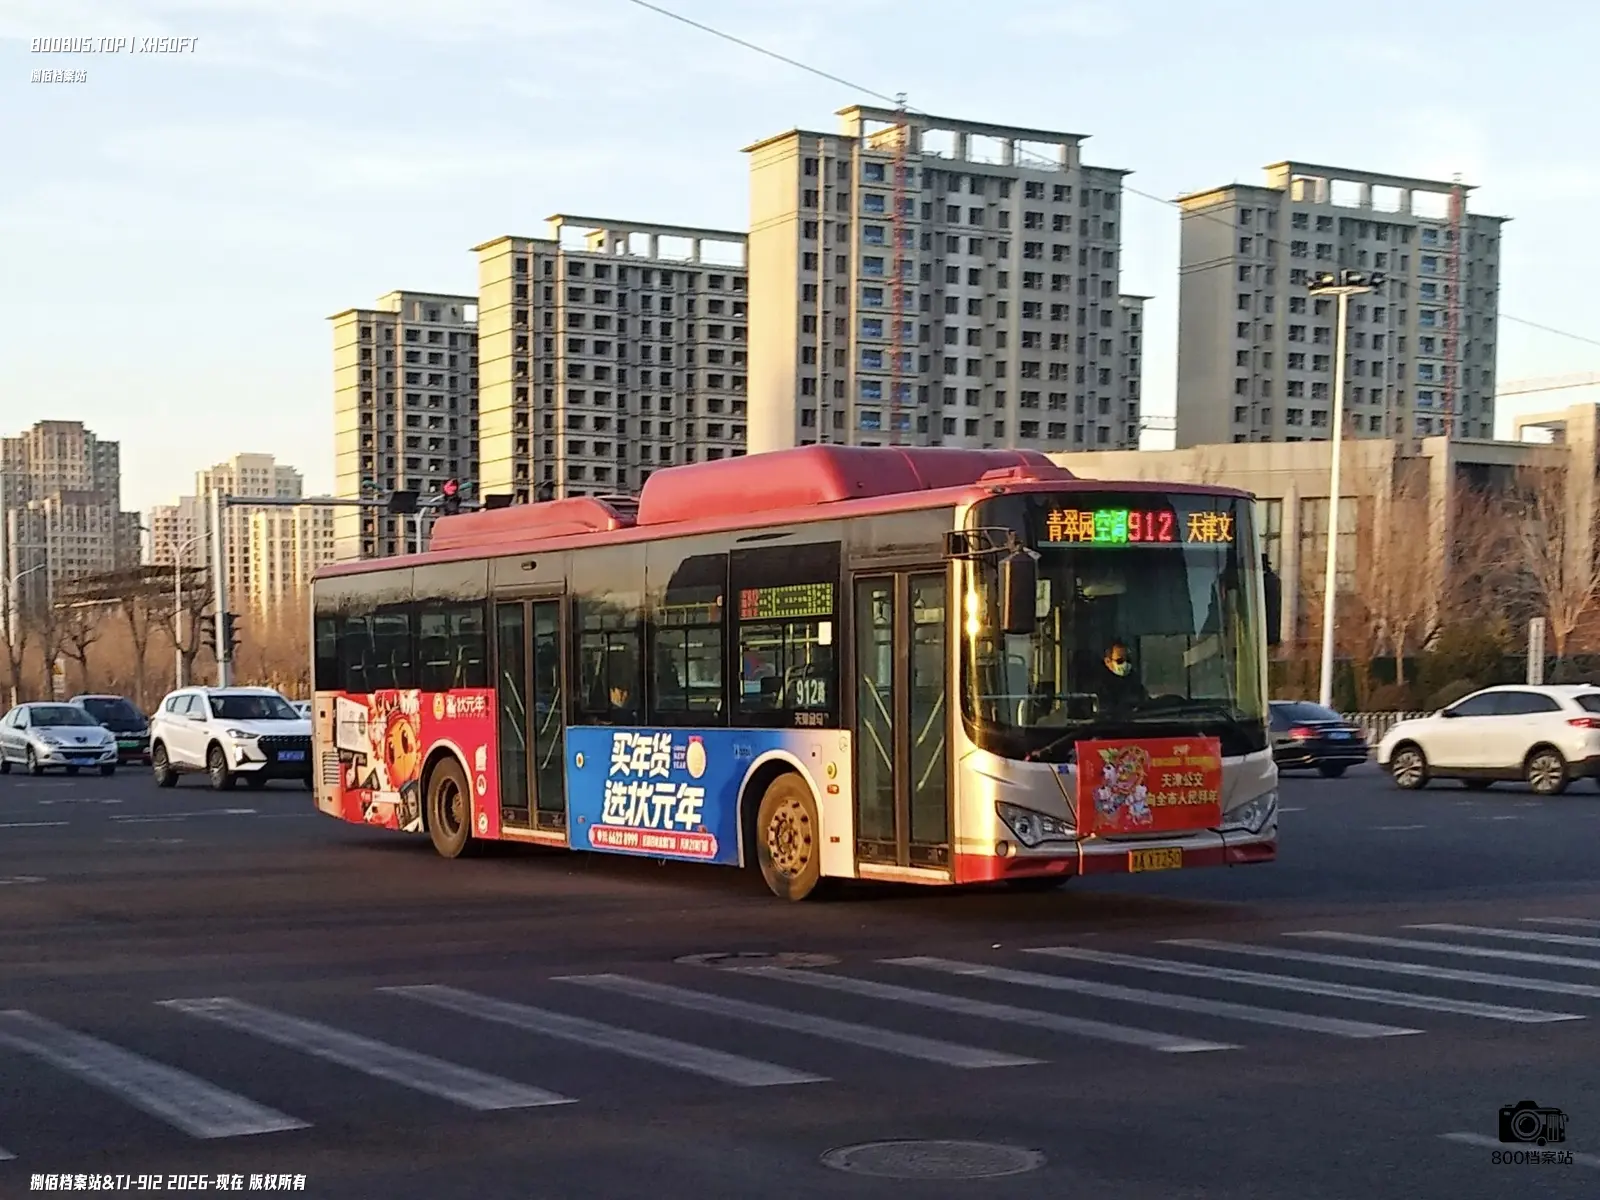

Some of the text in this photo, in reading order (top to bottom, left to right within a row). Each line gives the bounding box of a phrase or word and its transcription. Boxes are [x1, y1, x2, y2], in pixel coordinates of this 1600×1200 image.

[1128, 511, 1173, 542] 912
[1187, 511, 1234, 543] 天津文
[609, 732, 671, 778] 买年货
[602, 780, 704, 830] 选状元年
